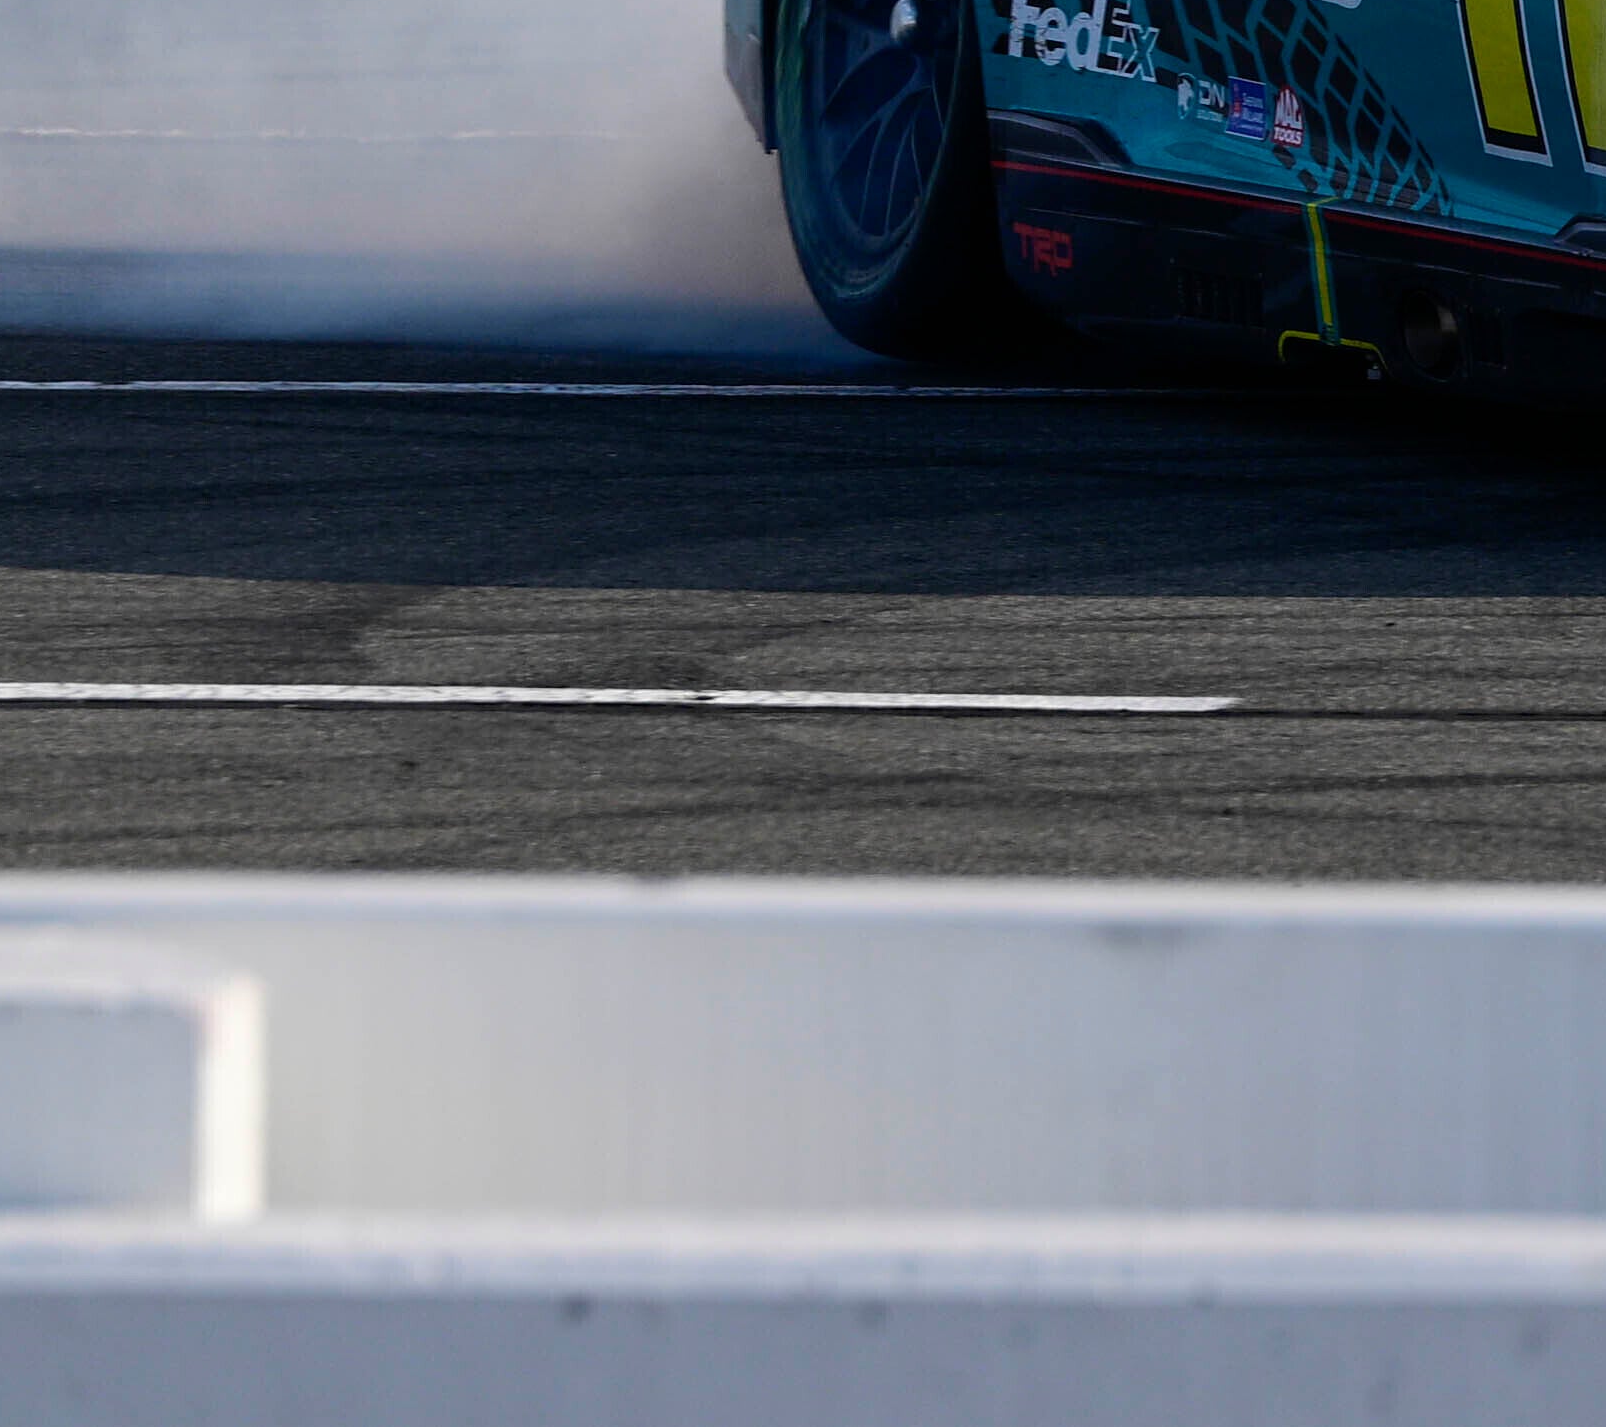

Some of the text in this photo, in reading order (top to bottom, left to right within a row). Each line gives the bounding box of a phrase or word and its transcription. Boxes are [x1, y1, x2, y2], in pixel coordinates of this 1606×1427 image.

[1274, 87, 1303, 130] MAC
[1273, 126, 1303, 145] TOOLS
[1012, 221, 1076, 277] TRD
